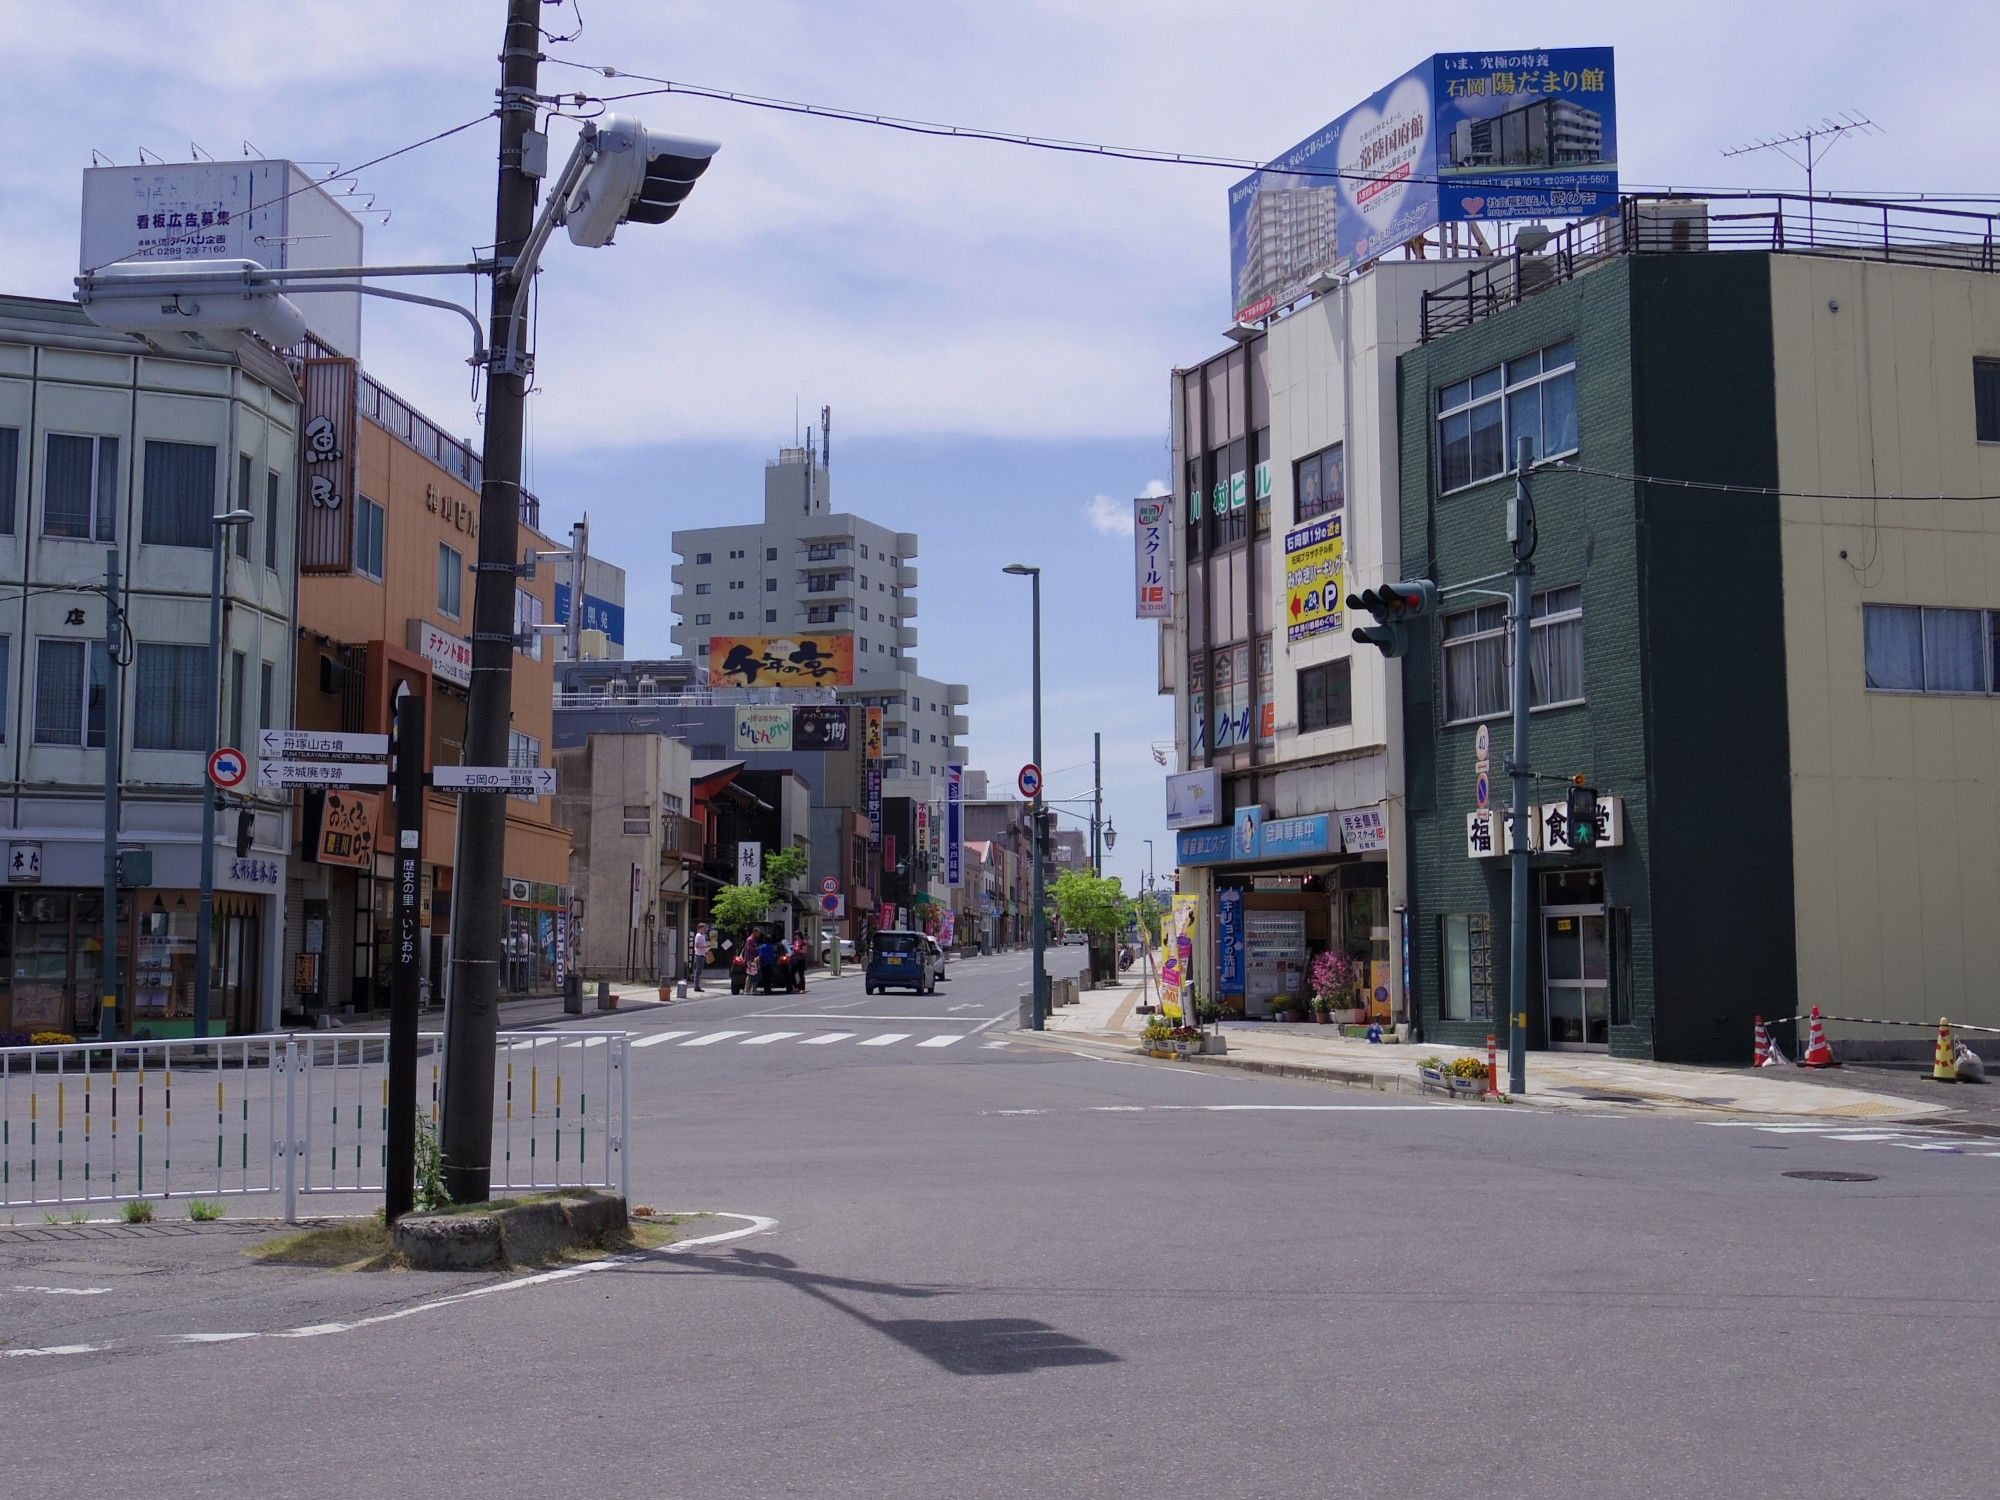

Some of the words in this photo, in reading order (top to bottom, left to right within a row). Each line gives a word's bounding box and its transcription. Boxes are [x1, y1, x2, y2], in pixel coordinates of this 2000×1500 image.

[1446, 78, 1487, 98] 石岡
[1491, 68, 1606, 97] 陽だまり館
[137, 211, 230, 230] 看板広告募集
[1144, 527, 1162, 585] スクール
[1141, 586, 1164, 602] IE
[1325, 583, 1338, 610] P
[430, 633, 470, 668] テナント募集
[722, 640, 838, 685] 千年の宴
[284, 737, 344, 751] 舟塚山古墳
[1478, 735, 1486, 750] 40
[283, 750, 331, 759] FUNATSUKAYAMA
[283, 766, 343, 780] 茨城廃寺跡
[465, 774, 533, 786] 石岡の一里塚
[306, 782, 329, 790] TEMPLE
[472, 786, 497, 794] STONES
[1266, 820, 1315, 843] 会員募集中
[949, 842, 958, 880] 水戸証券
[825, 881, 835, 890] 40
[401, 859, 415, 964] 歴史の里・いしおか
[1223, 901, 1236, 979] キリョウの洗顔
